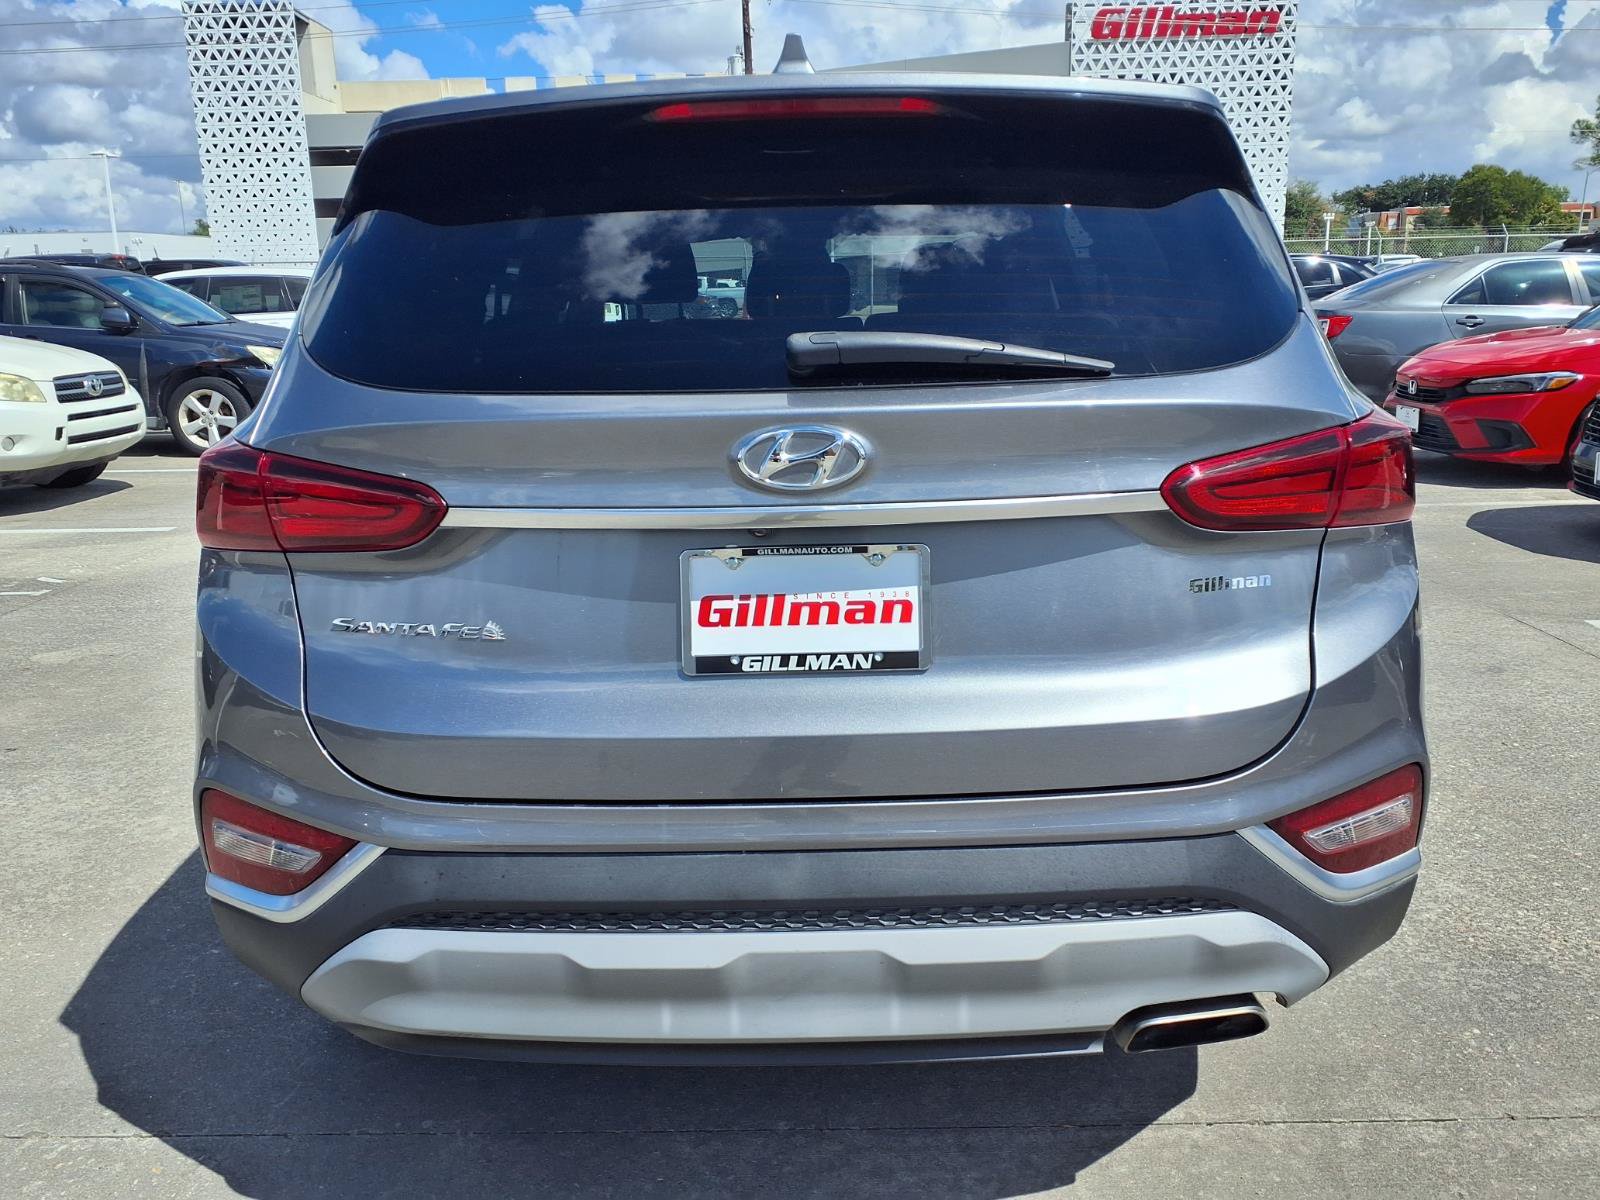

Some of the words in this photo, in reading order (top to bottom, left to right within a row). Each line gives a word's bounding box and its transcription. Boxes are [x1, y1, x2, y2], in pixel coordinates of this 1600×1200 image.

[1091, 6, 1281, 40] Gillman
[757, 546, 853, 555] GILLMANAUTO.COM
[793, 592, 849, 600] SINCE
[698, 594, 913, 628] Gillman
[331, 617, 436, 636] SANTA
[439, 622, 482, 639] FE
[741, 653, 873, 672] GILLMAN
